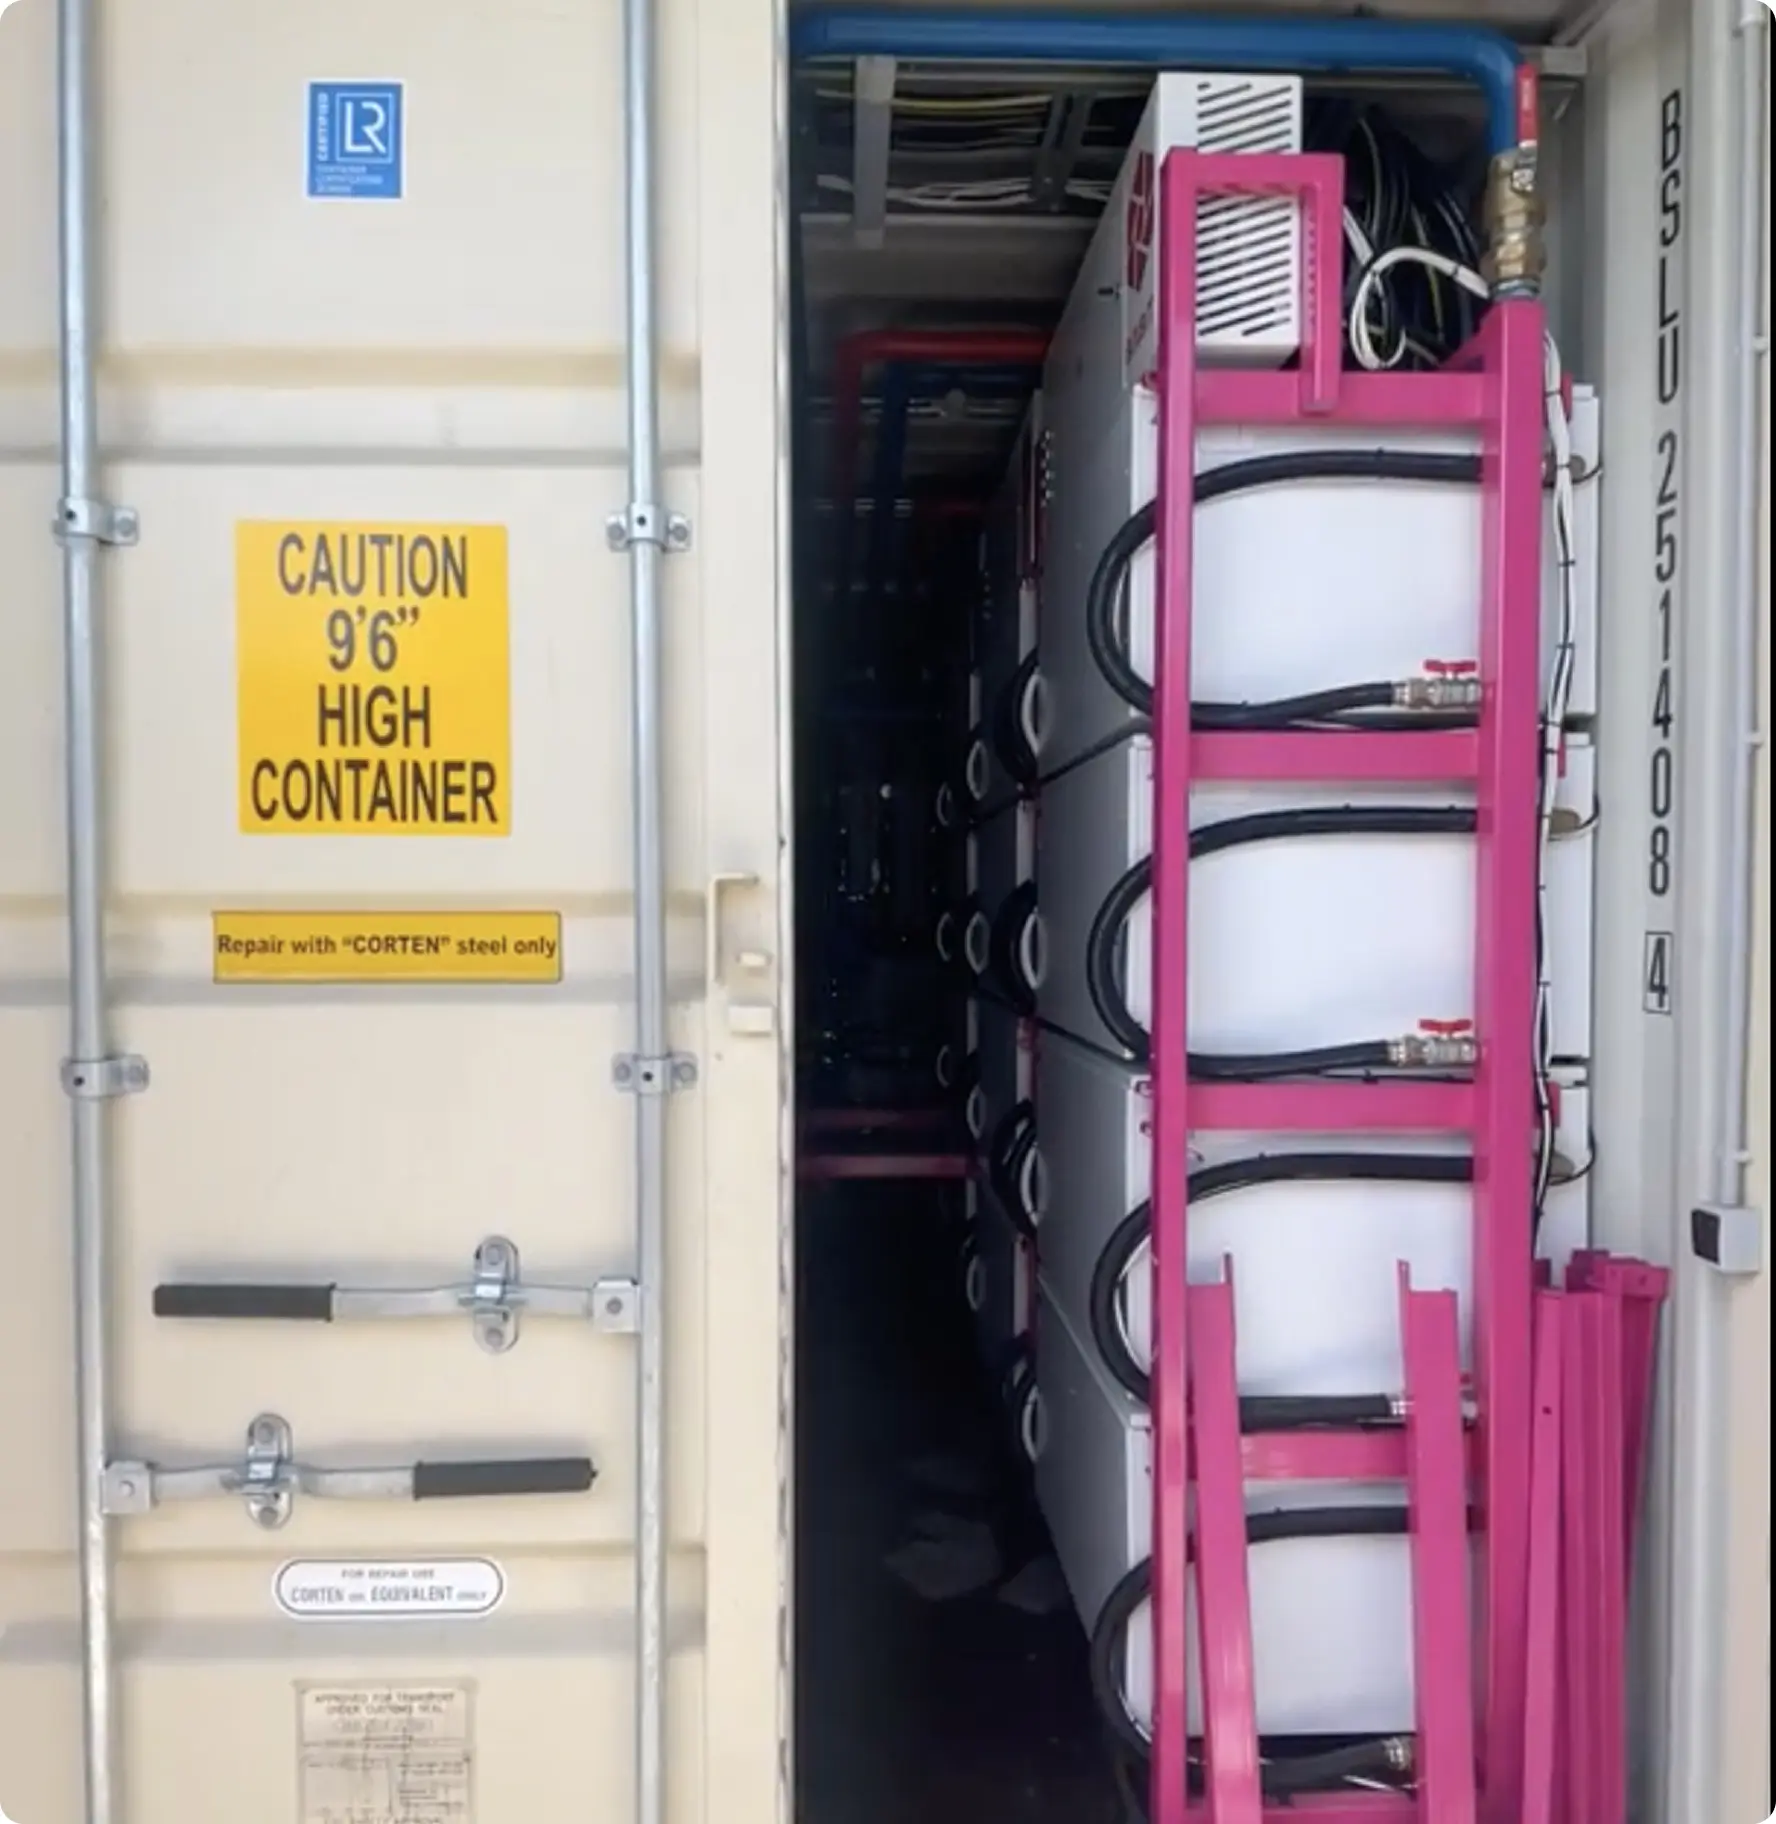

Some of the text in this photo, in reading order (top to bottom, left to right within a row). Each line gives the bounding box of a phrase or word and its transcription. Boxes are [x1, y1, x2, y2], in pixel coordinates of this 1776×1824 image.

[345, 101, 387, 154] LR
[277, 533, 469, 599] CAUTION
[1648, 89, 1682, 1010] BSLU 251408 4
[317, 684, 432, 749] HIGH
[251, 758, 499, 824] CONTAINER
[217, 934, 284, 958] Repair
[291, 935, 337, 955] with
[456, 936, 507, 955] steel
[514, 936, 557, 959] only
[291, 1586, 344, 1603] CORTEN
[370, 1585, 454, 1602] EQUIVALENT
[341, 1569, 364, 1579] FOR
[368, 1569, 409, 1579] REPAIR
